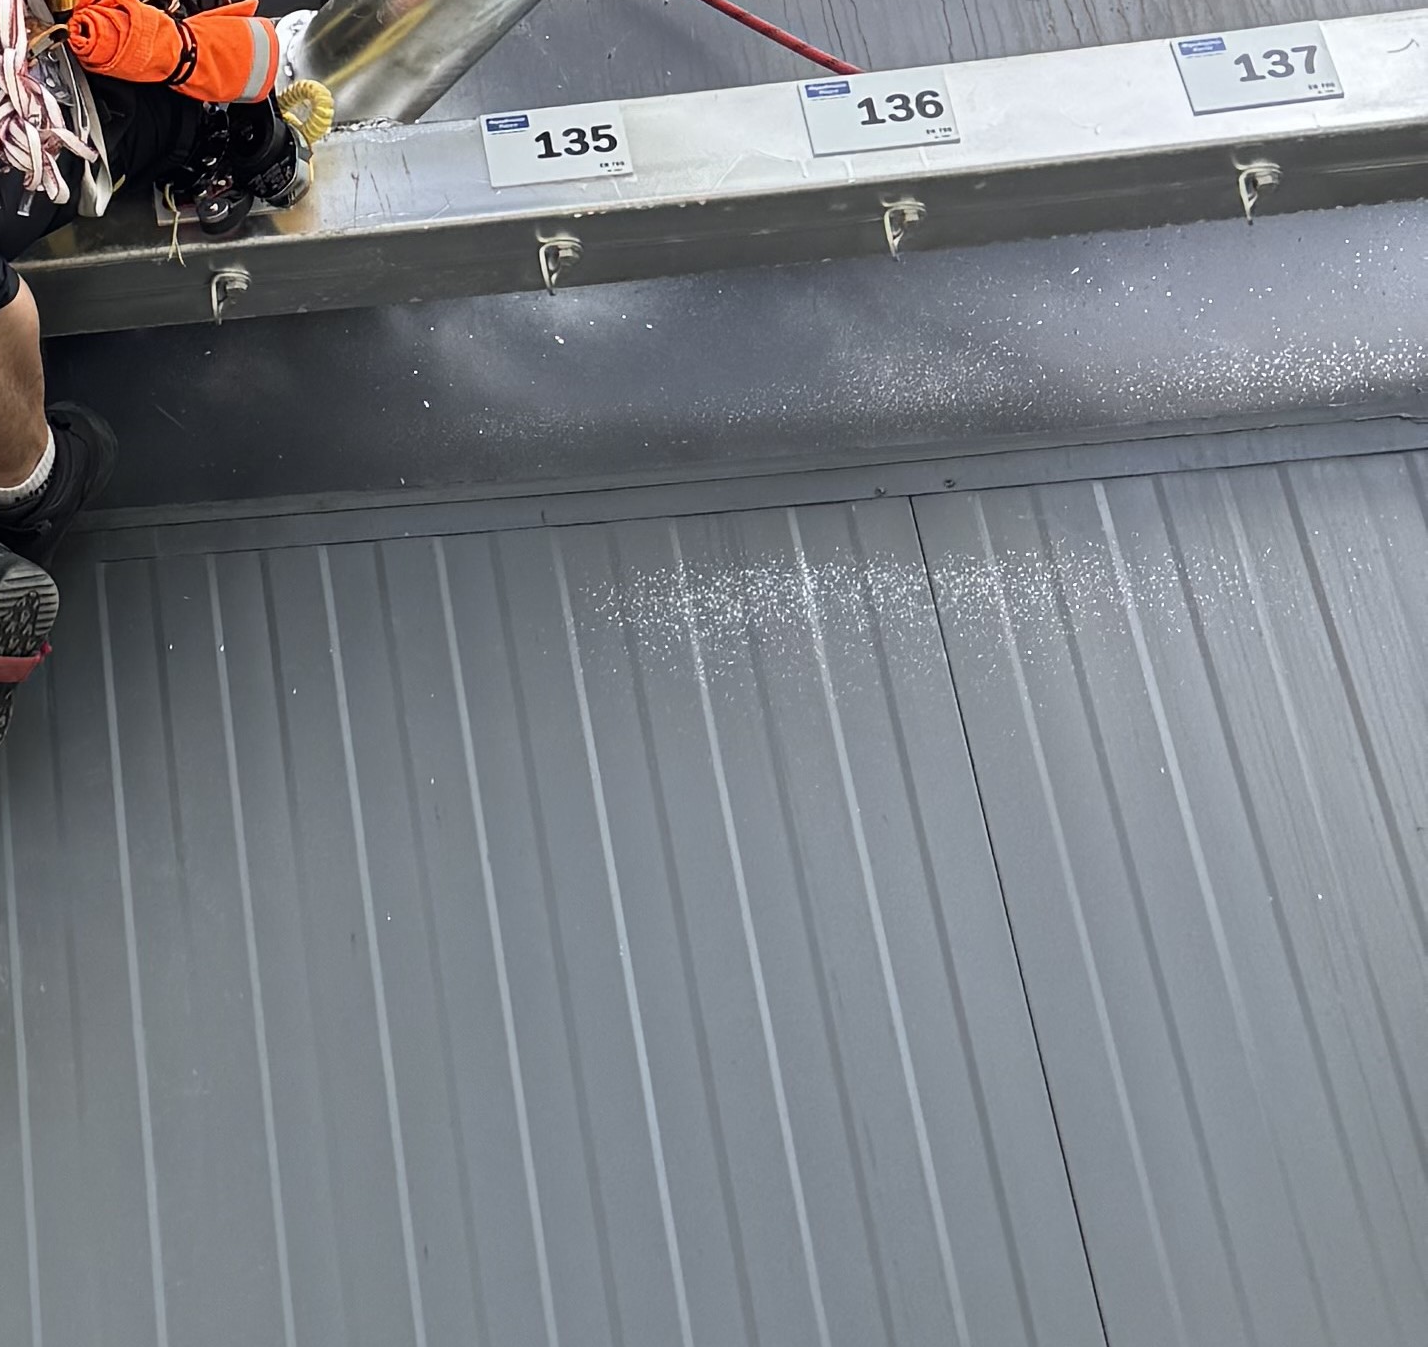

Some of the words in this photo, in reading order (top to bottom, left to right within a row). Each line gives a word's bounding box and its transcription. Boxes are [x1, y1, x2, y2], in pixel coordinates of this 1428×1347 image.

[1233, 45, 1318, 83] 137
[856, 89, 945, 126] 136
[533, 124, 619, 160] 135
